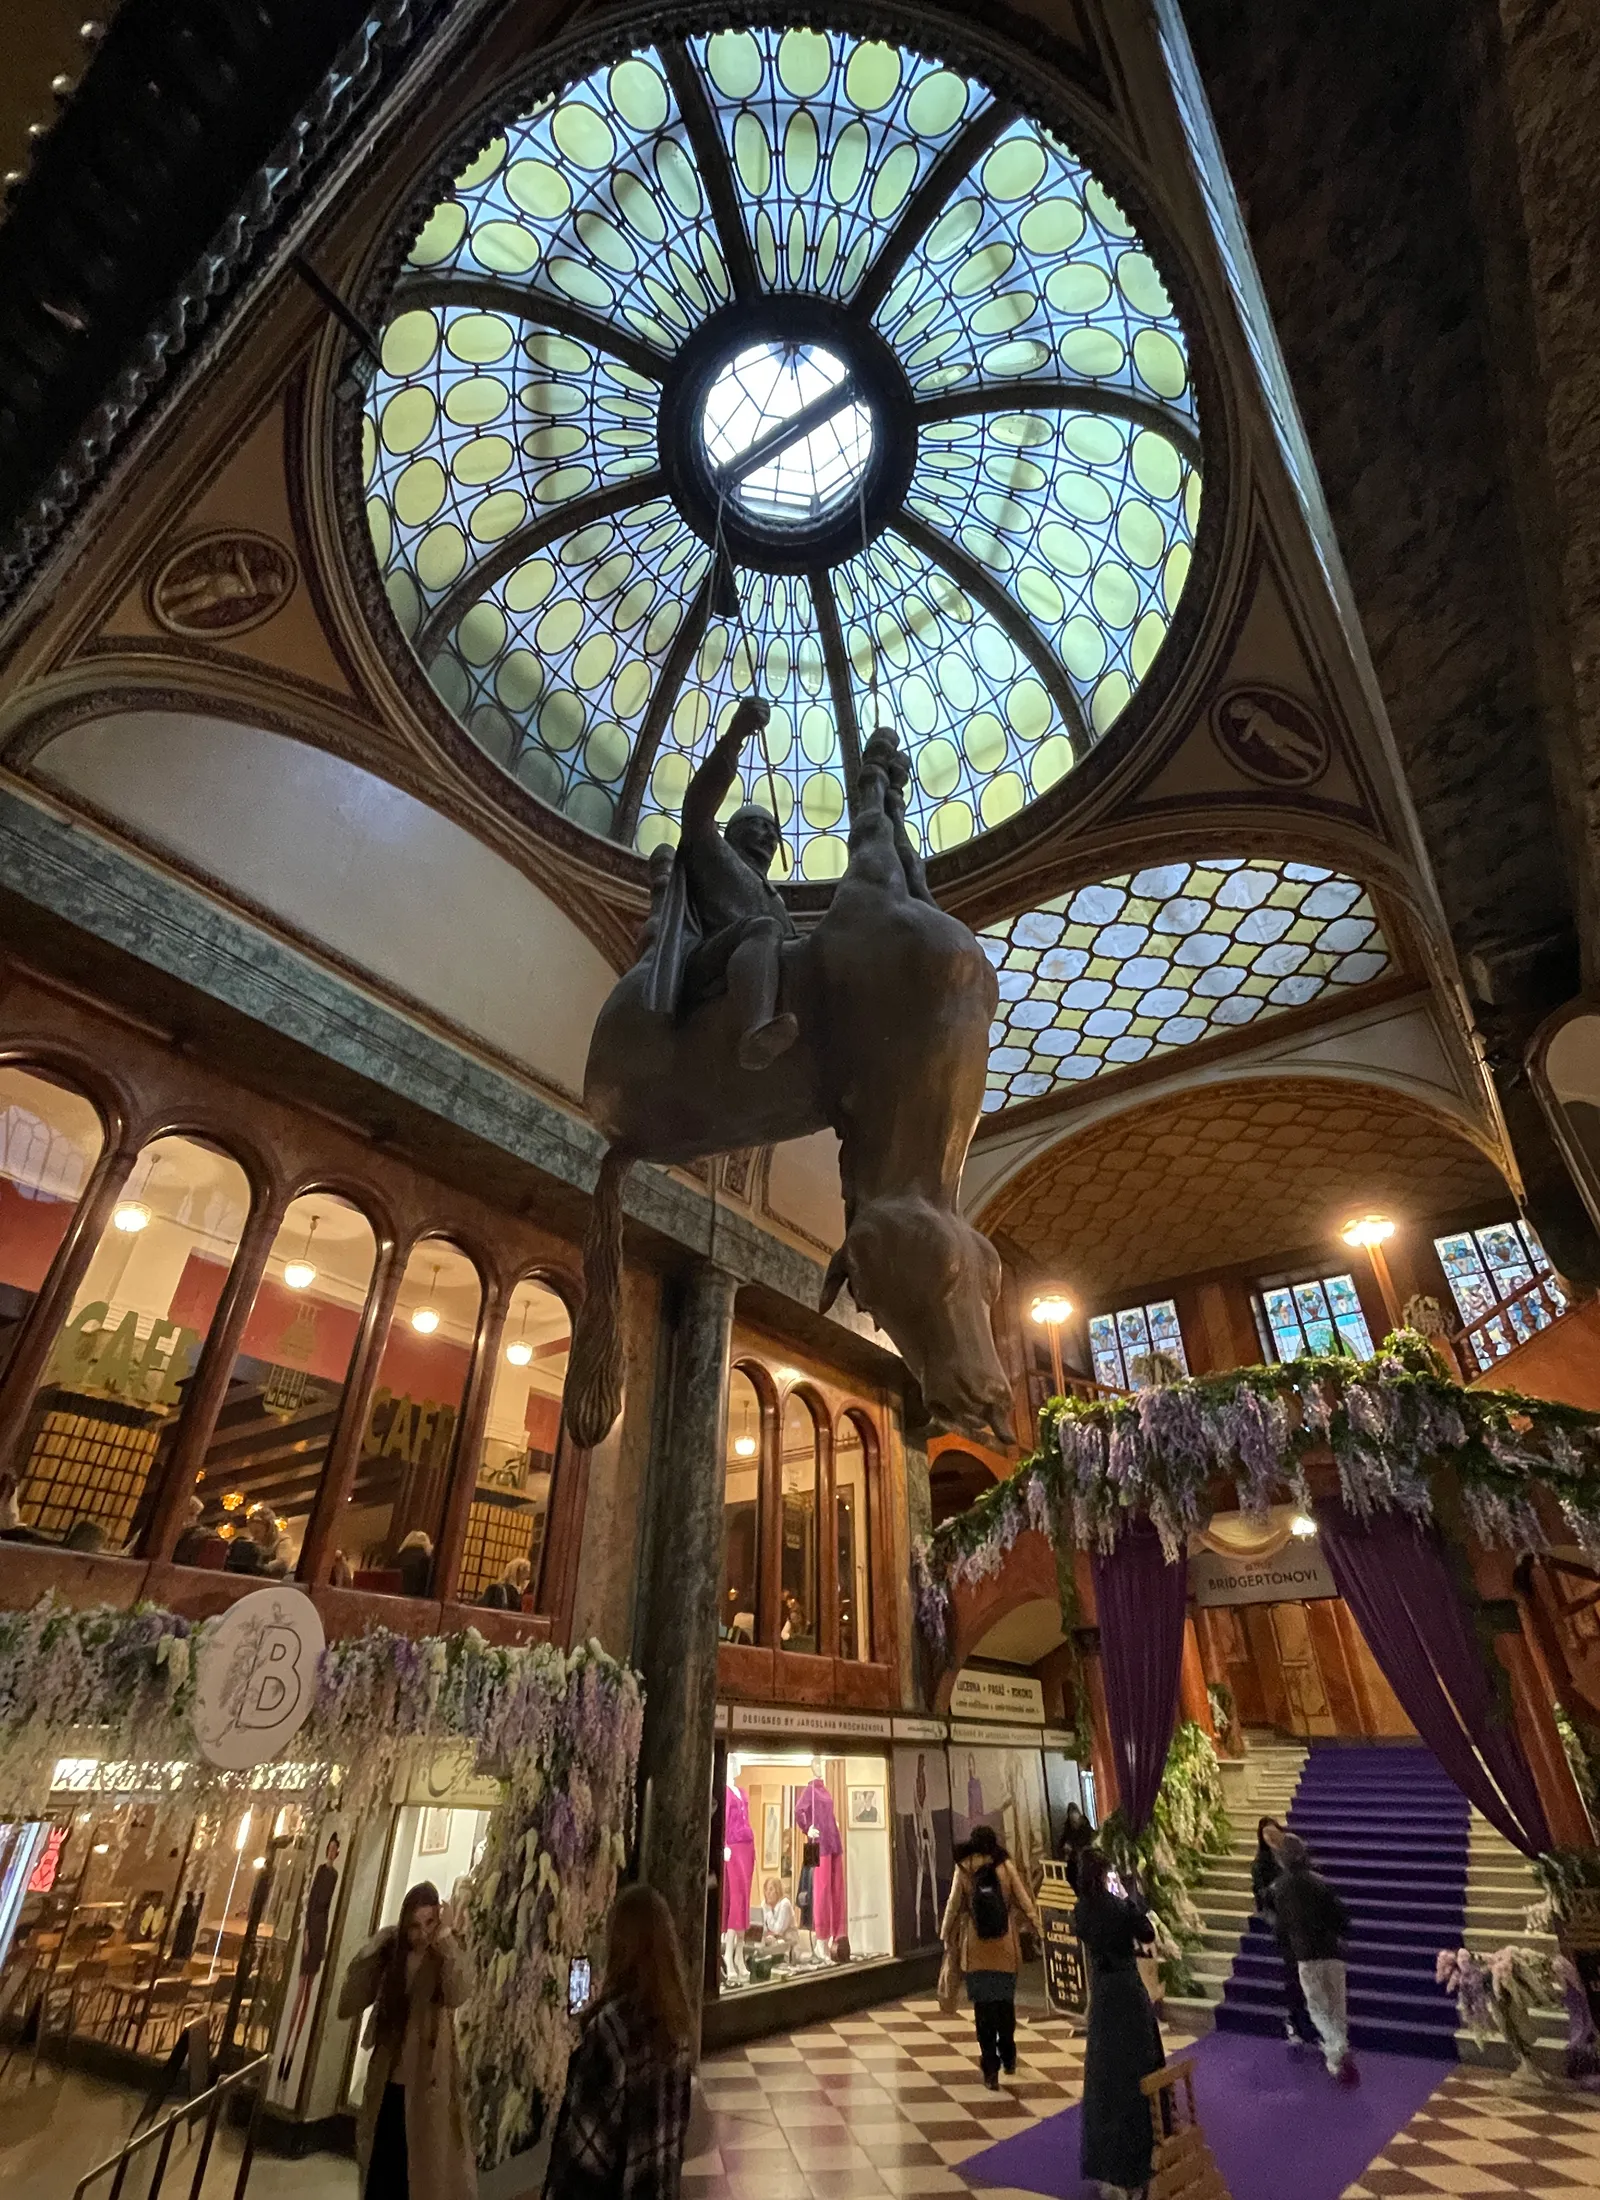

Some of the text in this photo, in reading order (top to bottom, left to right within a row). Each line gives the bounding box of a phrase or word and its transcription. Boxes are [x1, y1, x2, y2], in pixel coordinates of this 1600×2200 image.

[1208, 1569, 1318, 1590] BRIDGERTONOVI
[235, 1625, 301, 1729] B
[742, 1713, 781, 1726] DESIGNED
[784, 1717, 794, 1727] BY
[796, 1718, 836, 1729] JAROSLAVA
